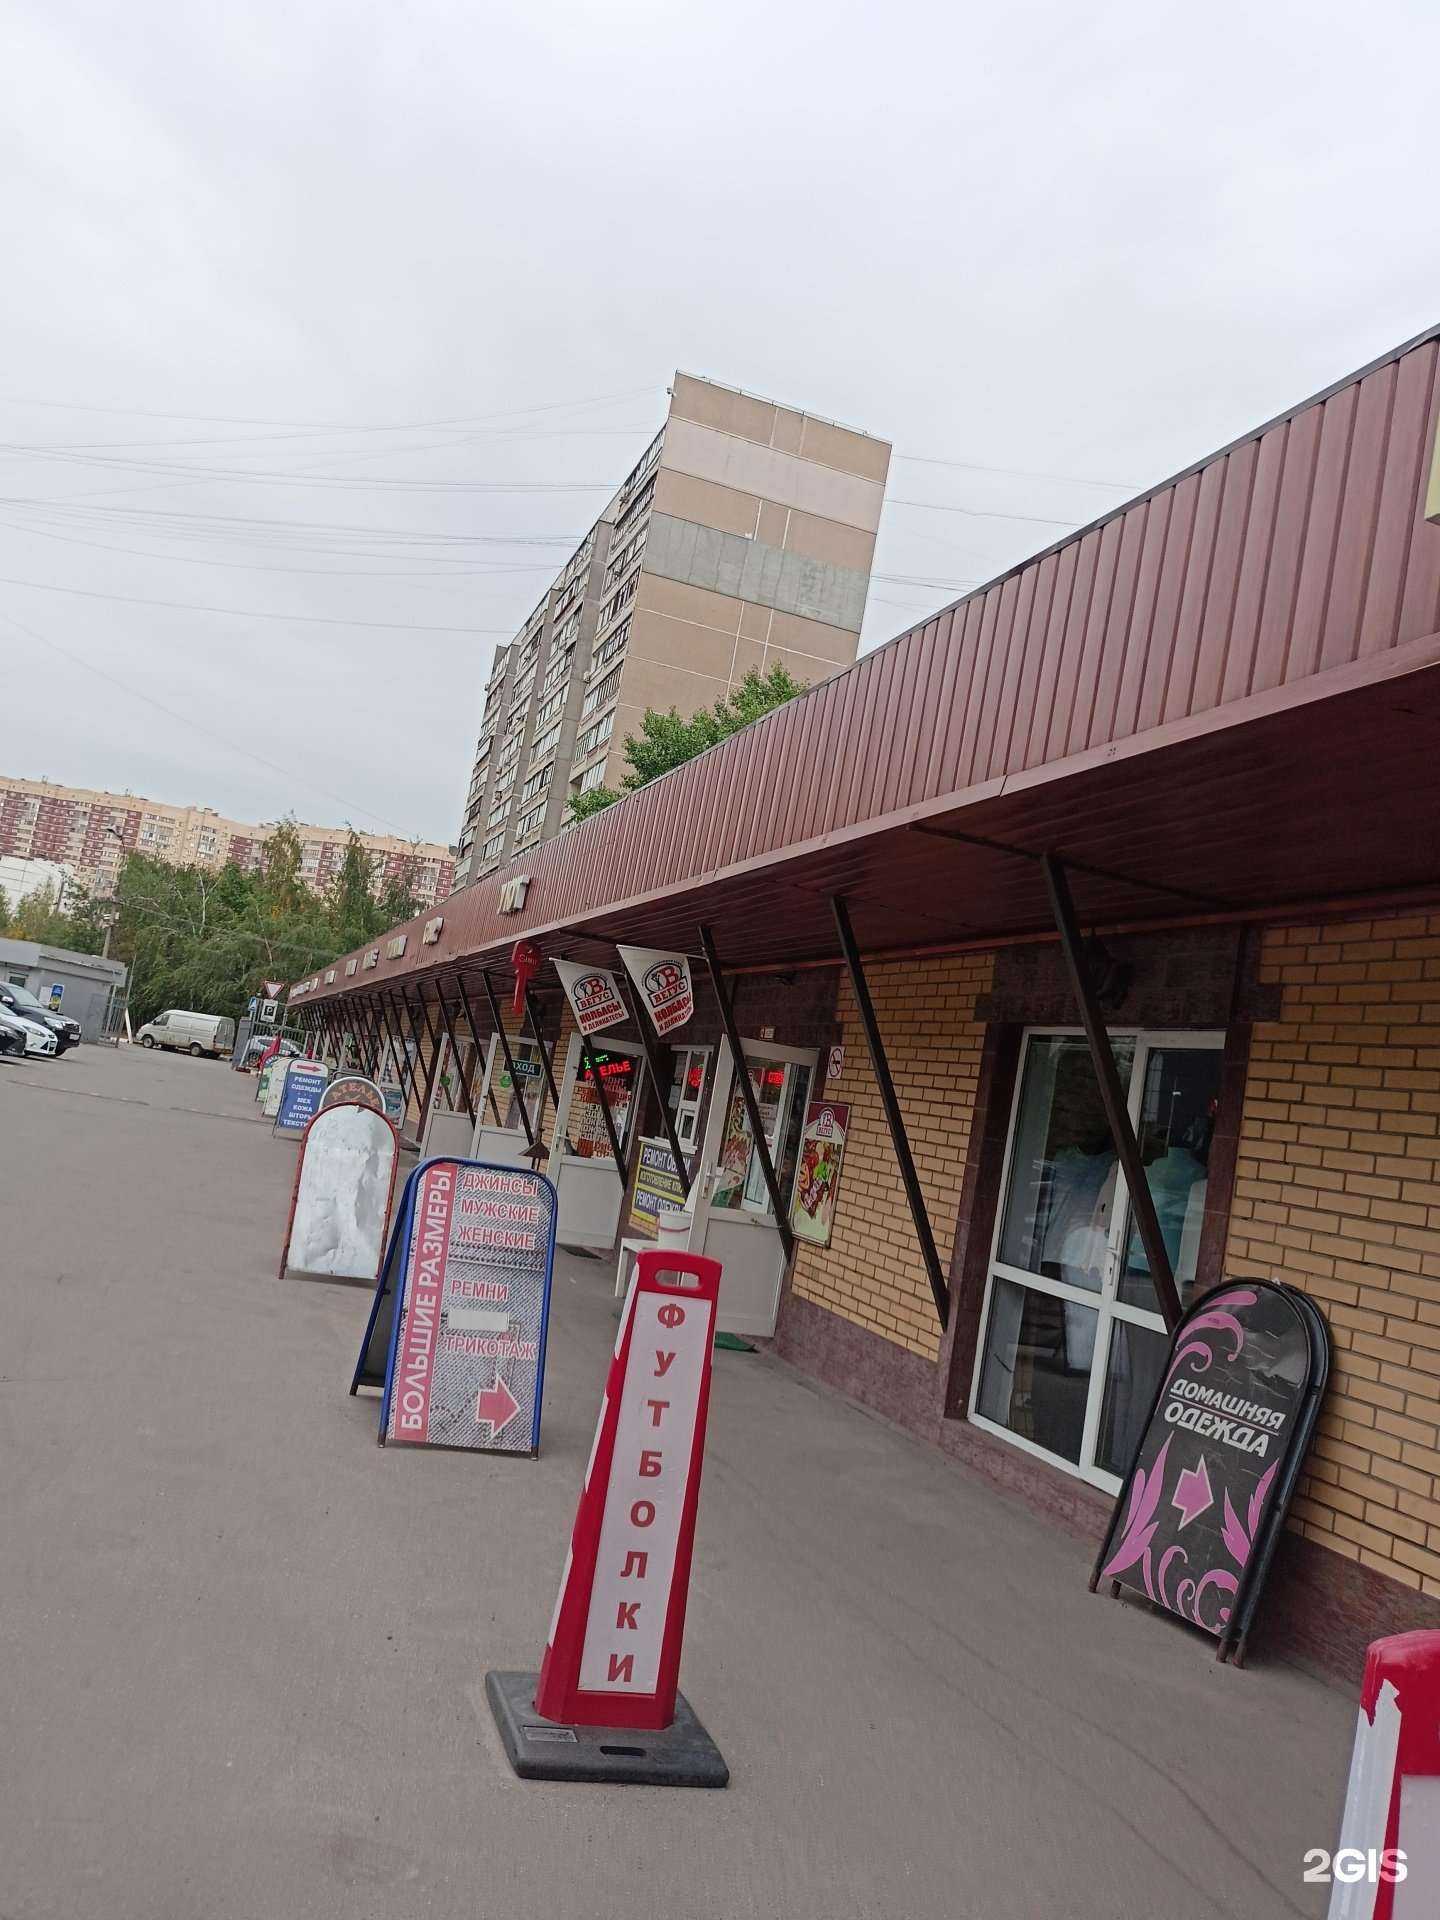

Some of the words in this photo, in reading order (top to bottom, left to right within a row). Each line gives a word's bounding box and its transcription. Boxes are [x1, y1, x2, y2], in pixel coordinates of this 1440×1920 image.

[580, 991, 610, 1009] ВЕГУС
[653, 981, 686, 1003] ВЕГУС
[579, 1001, 622, 1024] КОЛБАСЫ
[587, 1011, 625, 1031] ДЕЛИКАТЕСЫ
[294, 1076, 322, 1085] РЕМОНТ
[583, 1061, 631, 1081] АЕЛЬЕ
[291, 1084, 322, 1093] ОДЕЖДЫ
[292, 1104, 313, 1112] КОЖА
[642, 1147, 667, 1169] РЕМОНТ
[463, 1172, 539, 1197] ДЖИНСЫ
[460, 1198, 540, 1223] МУЖСКИЕ
[636, 1190, 657, 1211] РЕМОНТ
[418, 1170, 453, 1288] РАЗМЕРЫ
[457, 1224, 536, 1249] ЖЕНСКИЕ
[451, 1279, 509, 1301] РЕМНИ
[445, 1335, 536, 1360] ТРИКОТАЖ
[401, 1294, 438, 1431] БОЛЬШИЕ
[1170, 1378, 1286, 1430] ДОМАШНЯЯ
[1164, 1401, 1270, 1458] ОДЕЖДА
[607, 1303, 686, 1684] ФУТБОЛКИ
